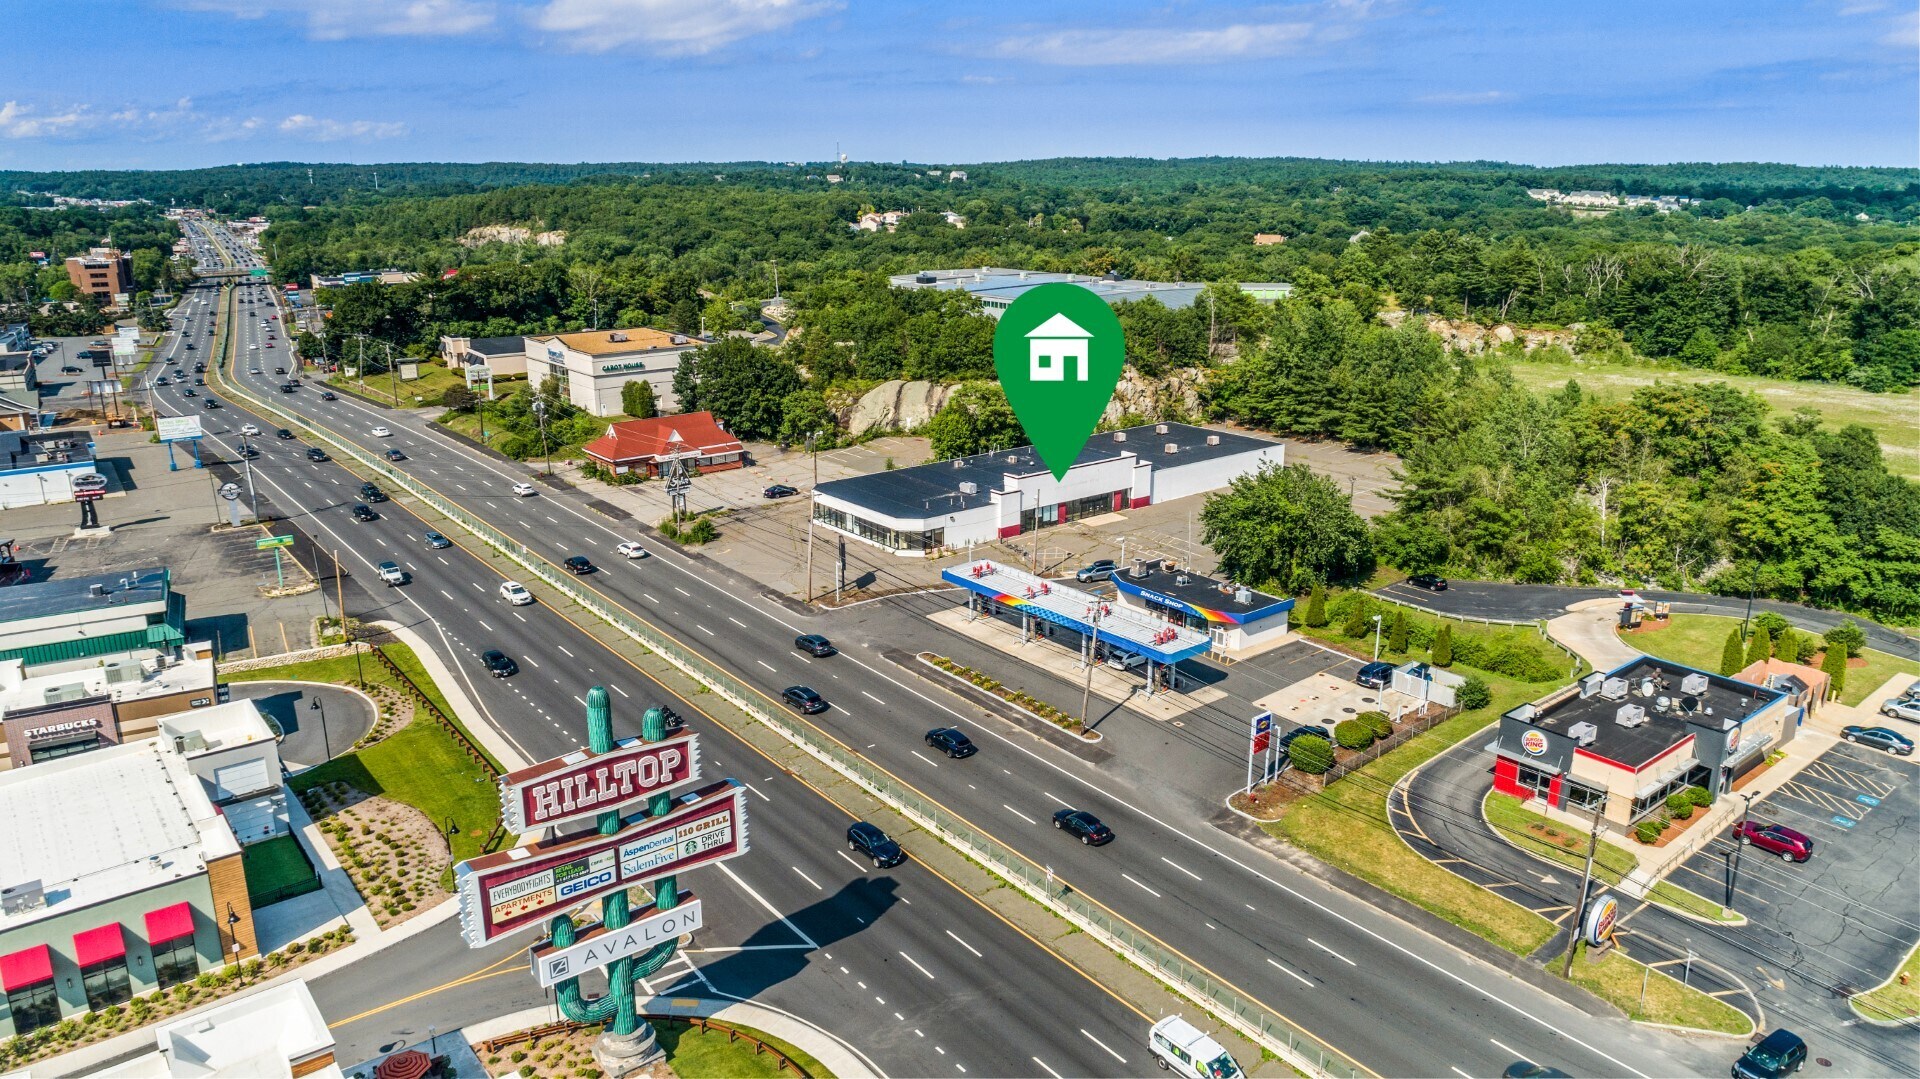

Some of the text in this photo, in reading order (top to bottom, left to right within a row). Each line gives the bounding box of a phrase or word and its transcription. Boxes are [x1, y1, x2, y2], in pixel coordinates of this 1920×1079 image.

[602, 363, 621, 372] CABOT
[1140, 590, 1183, 608] SNACK SHOP
[24, 718, 97, 737] STARBUCKS
[532, 748, 681, 821] HILLTOP
[678, 815, 729, 838] 110 GRILL
[701, 829, 725, 844] DRIVE
[702, 837, 724, 850] THRU
[555, 864, 573, 873] RETAIL
[556, 871, 567, 879] FOR
[569, 865, 585, 875] LEASE
[493, 873, 551, 902] EVERYBODYFIGHTS
[560, 871, 612, 896] GEICO
[494, 889, 553, 914] APARTMENTS
[584, 911, 695, 964] AVALON
